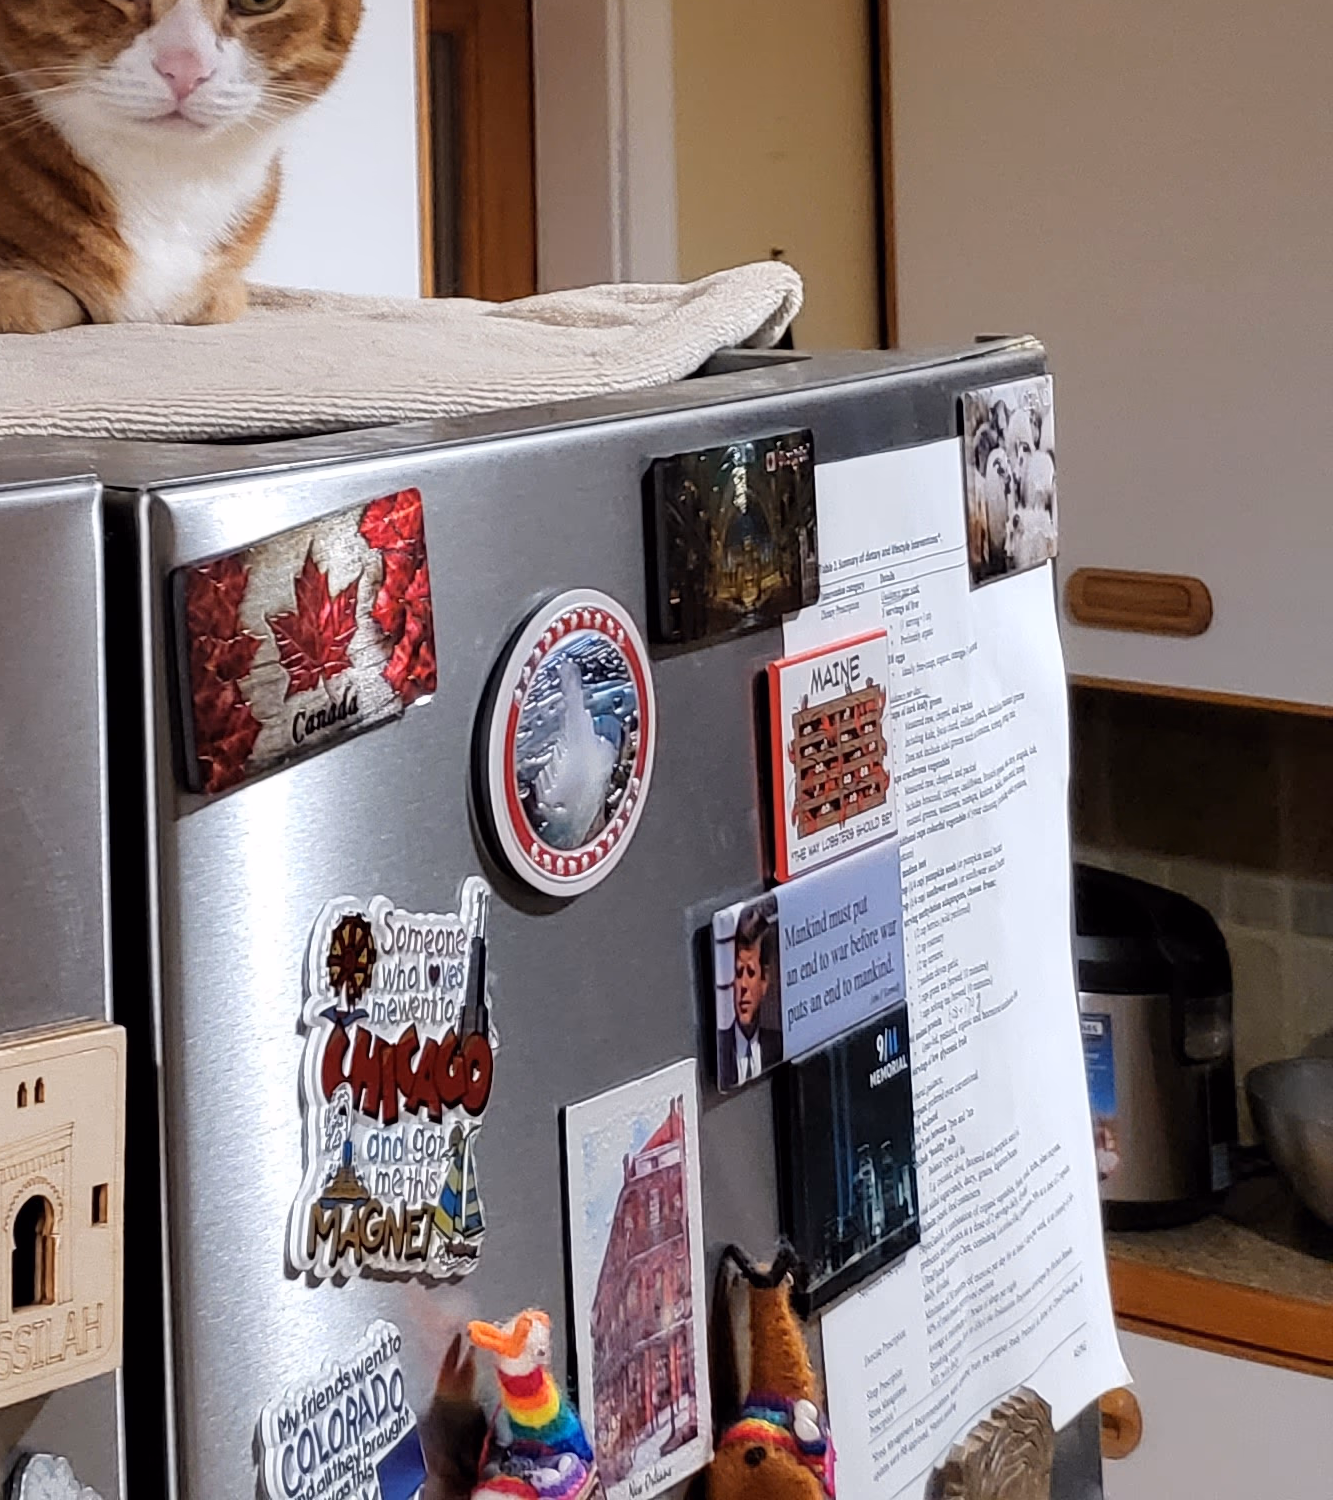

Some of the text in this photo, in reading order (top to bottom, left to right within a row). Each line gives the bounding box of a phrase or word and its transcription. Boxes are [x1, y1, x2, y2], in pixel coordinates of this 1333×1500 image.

[810, 654, 861, 696] MAINE
[292, 684, 359, 744] Canada
[381, 911, 467, 955] Someone
[784, 895, 868, 950] Mankind must put
[381, 957, 418, 991] who
[786, 919, 897, 987] an end to war before war
[787, 1001, 808, 1032] puts
[810, 994, 822, 1014] an
[824, 978, 841, 1006] end
[842, 978, 852, 996] to
[854, 951, 895, 992] mankind.
[876, 1026, 899, 1062] 9/11
[321, 1017, 494, 1126] CHICAGO
[869, 1054, 909, 1089] MEMORIAL
[367, 1128, 403, 1162] and
[374, 1166, 438, 1198] me this
[307, 1199, 434, 1267] MAGNET
[277, 1408, 300, 1444] My
[301, 1368, 351, 1424] friends
[352, 1338, 388, 1383] went
[281, 1368, 405, 1498] COLORADO
[362, 1406, 410, 1457] brought
